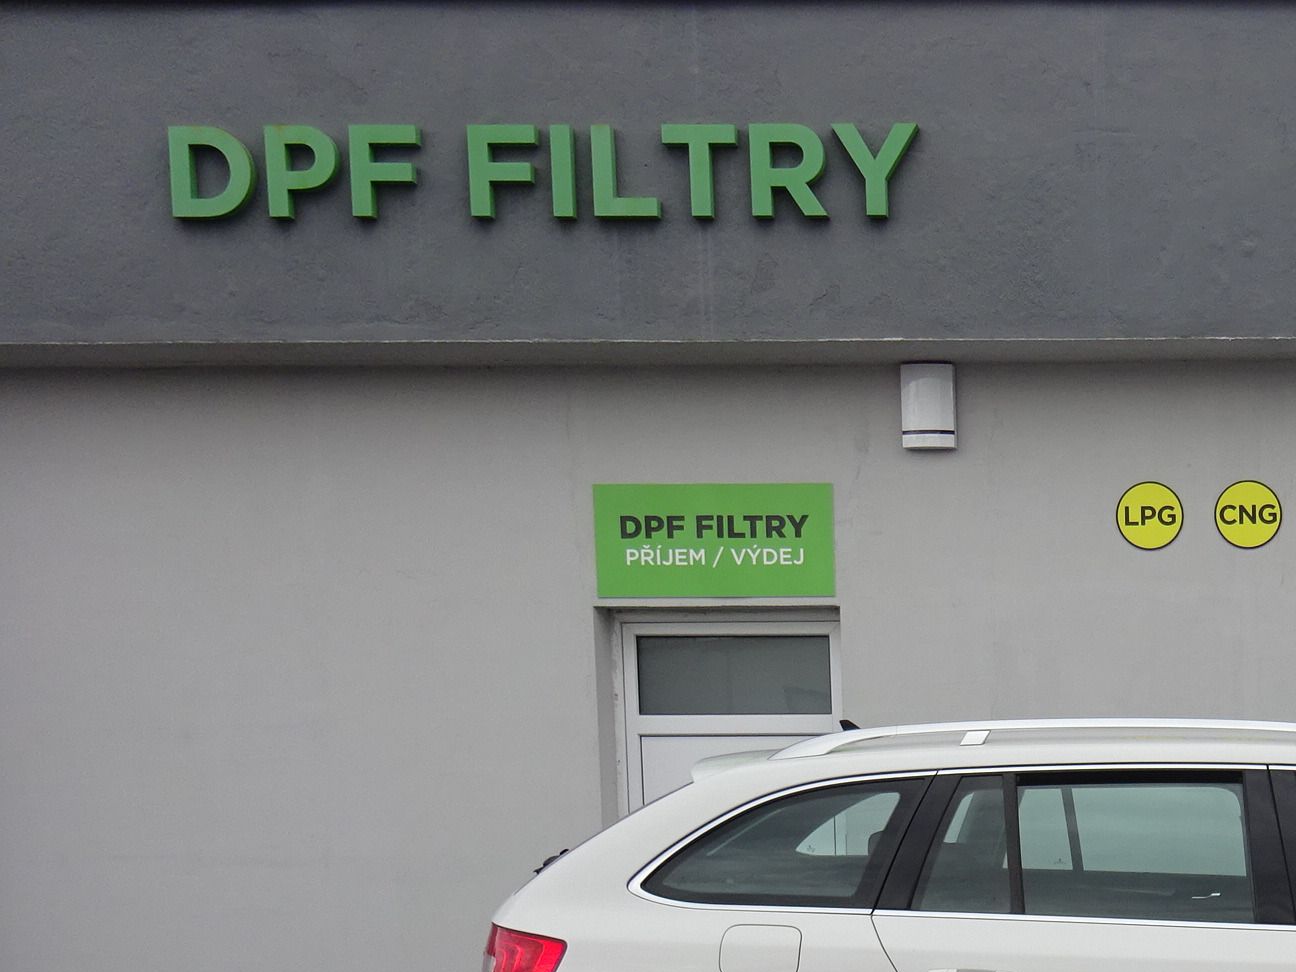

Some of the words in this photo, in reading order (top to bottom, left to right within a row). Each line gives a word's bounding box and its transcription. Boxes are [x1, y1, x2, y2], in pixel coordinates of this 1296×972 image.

[167, 123, 422, 220] DPF
[466, 122, 919, 219] FILTRY
[1125, 506, 1177, 526] LPG
[1220, 504, 1277, 525] CNG
[620, 515, 685, 539] DPF
[696, 515, 809, 539] FILTRY
[626, 545, 705, 565] PŘÍJEM
[712, 547, 724, 568] /
[731, 545, 804, 565] VÝDEJ
